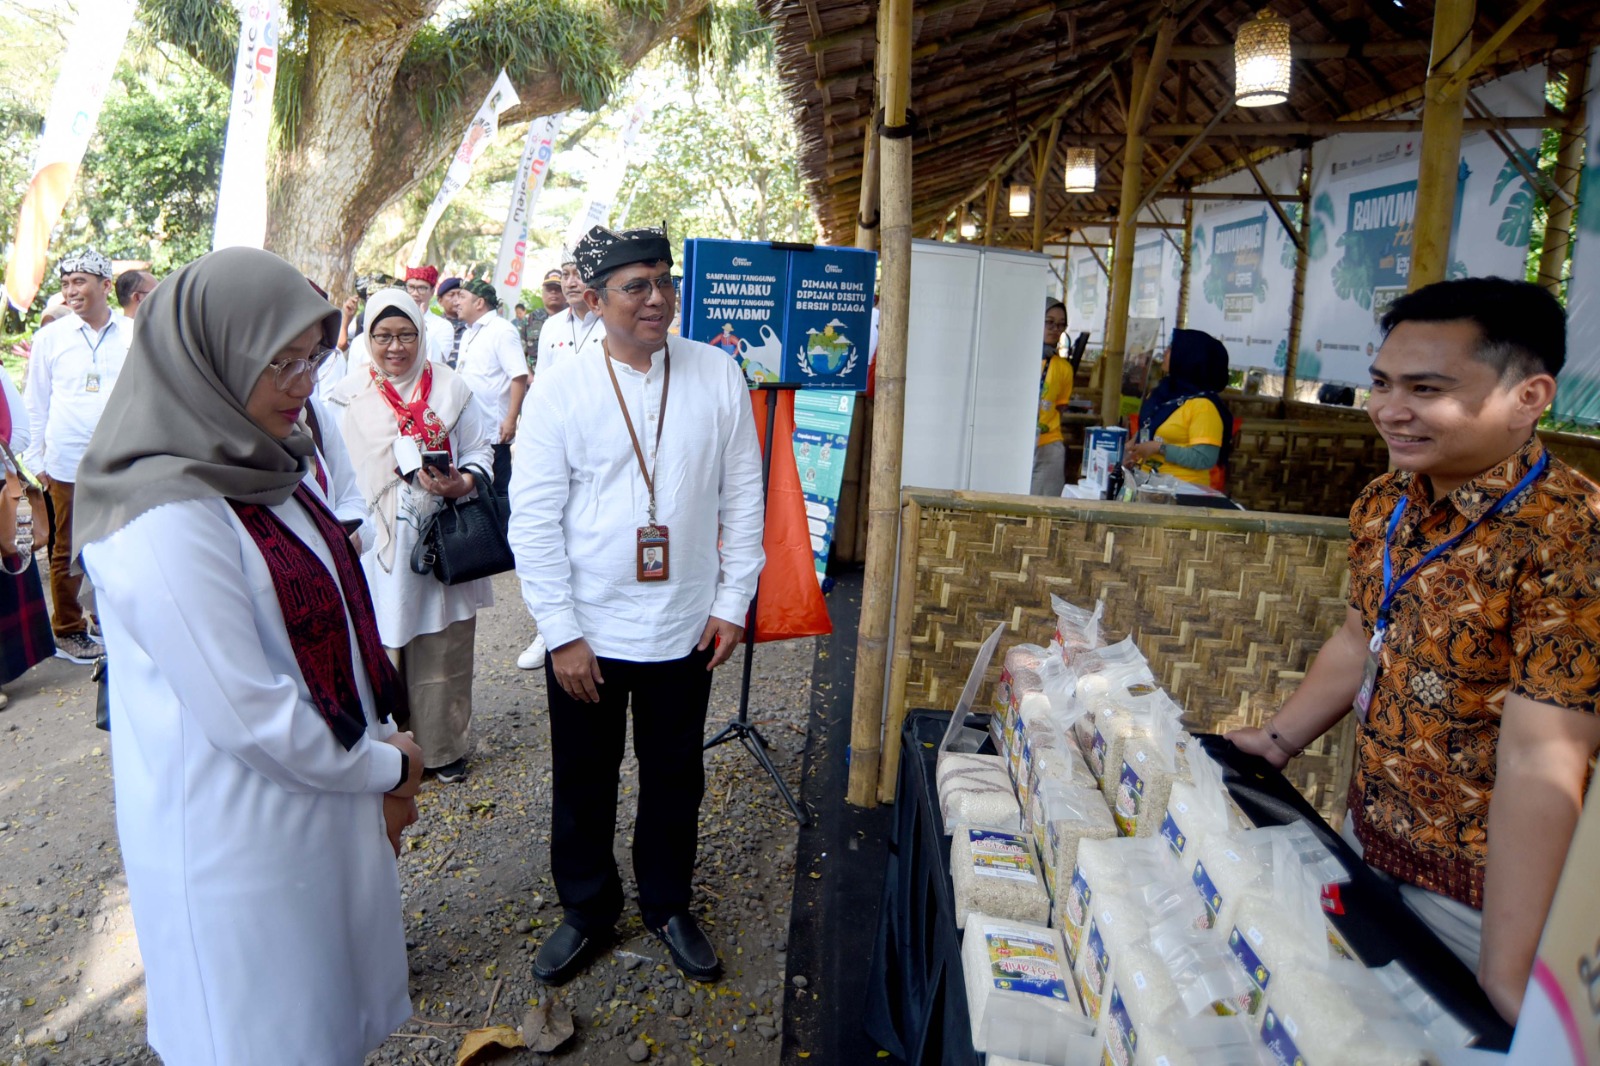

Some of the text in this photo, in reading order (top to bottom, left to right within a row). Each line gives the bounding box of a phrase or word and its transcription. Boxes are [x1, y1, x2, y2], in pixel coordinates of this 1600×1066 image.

[706, 272, 776, 283] SAMPAHKU TANGGUNG
[710, 283, 771, 296] JAWABKU
[802, 279, 863, 291] DIMANA BUMI
[797, 290, 866, 302] DIPIJAK DISITU
[703, 298, 775, 307] SAMPAHMU TANGGUNG
[796, 301, 865, 312] BERSIH DIJAGA
[706, 307, 771, 321] JAWABMU
[998, 961, 1060, 981] Botanik
